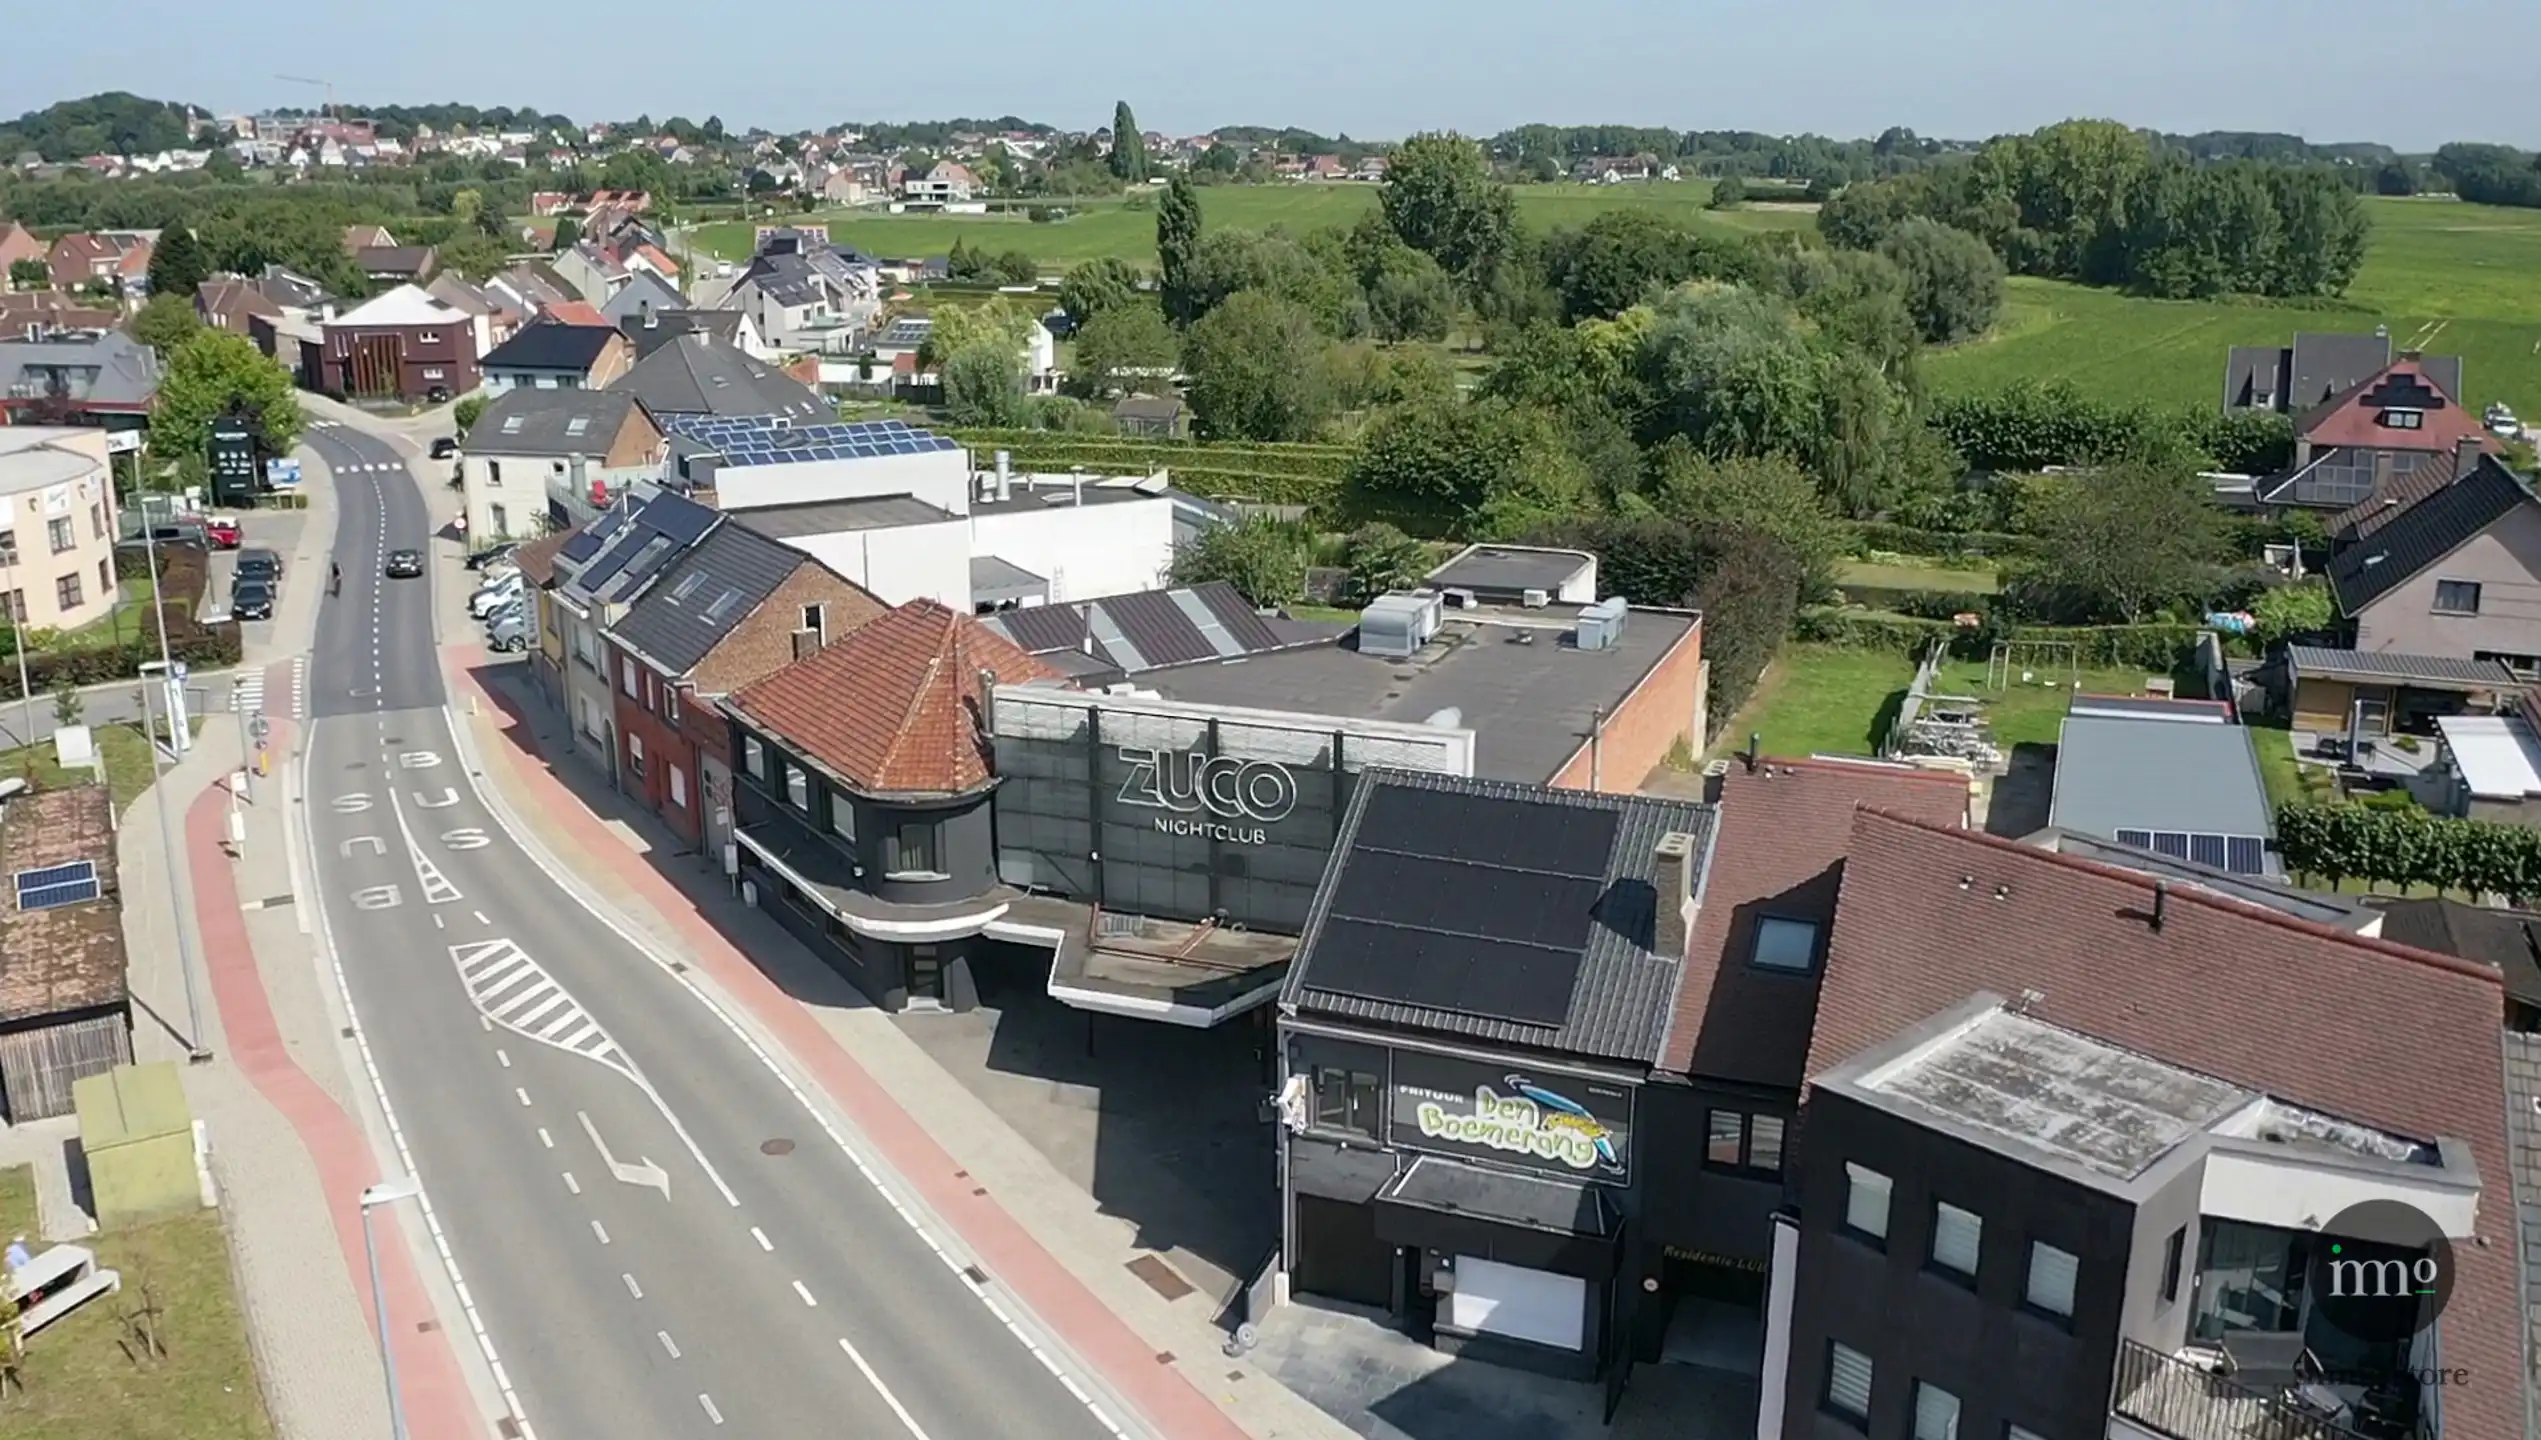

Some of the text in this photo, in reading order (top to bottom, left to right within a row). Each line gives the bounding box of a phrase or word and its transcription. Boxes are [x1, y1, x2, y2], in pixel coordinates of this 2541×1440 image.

[399, 750, 492, 850] BUS
[1116, 746, 1297, 822] ZUCO
[331, 793, 404, 911] BUS
[1154, 817, 1267, 845] NIGHTCLUB
[1419, 1104, 1596, 1166] Boemerang
